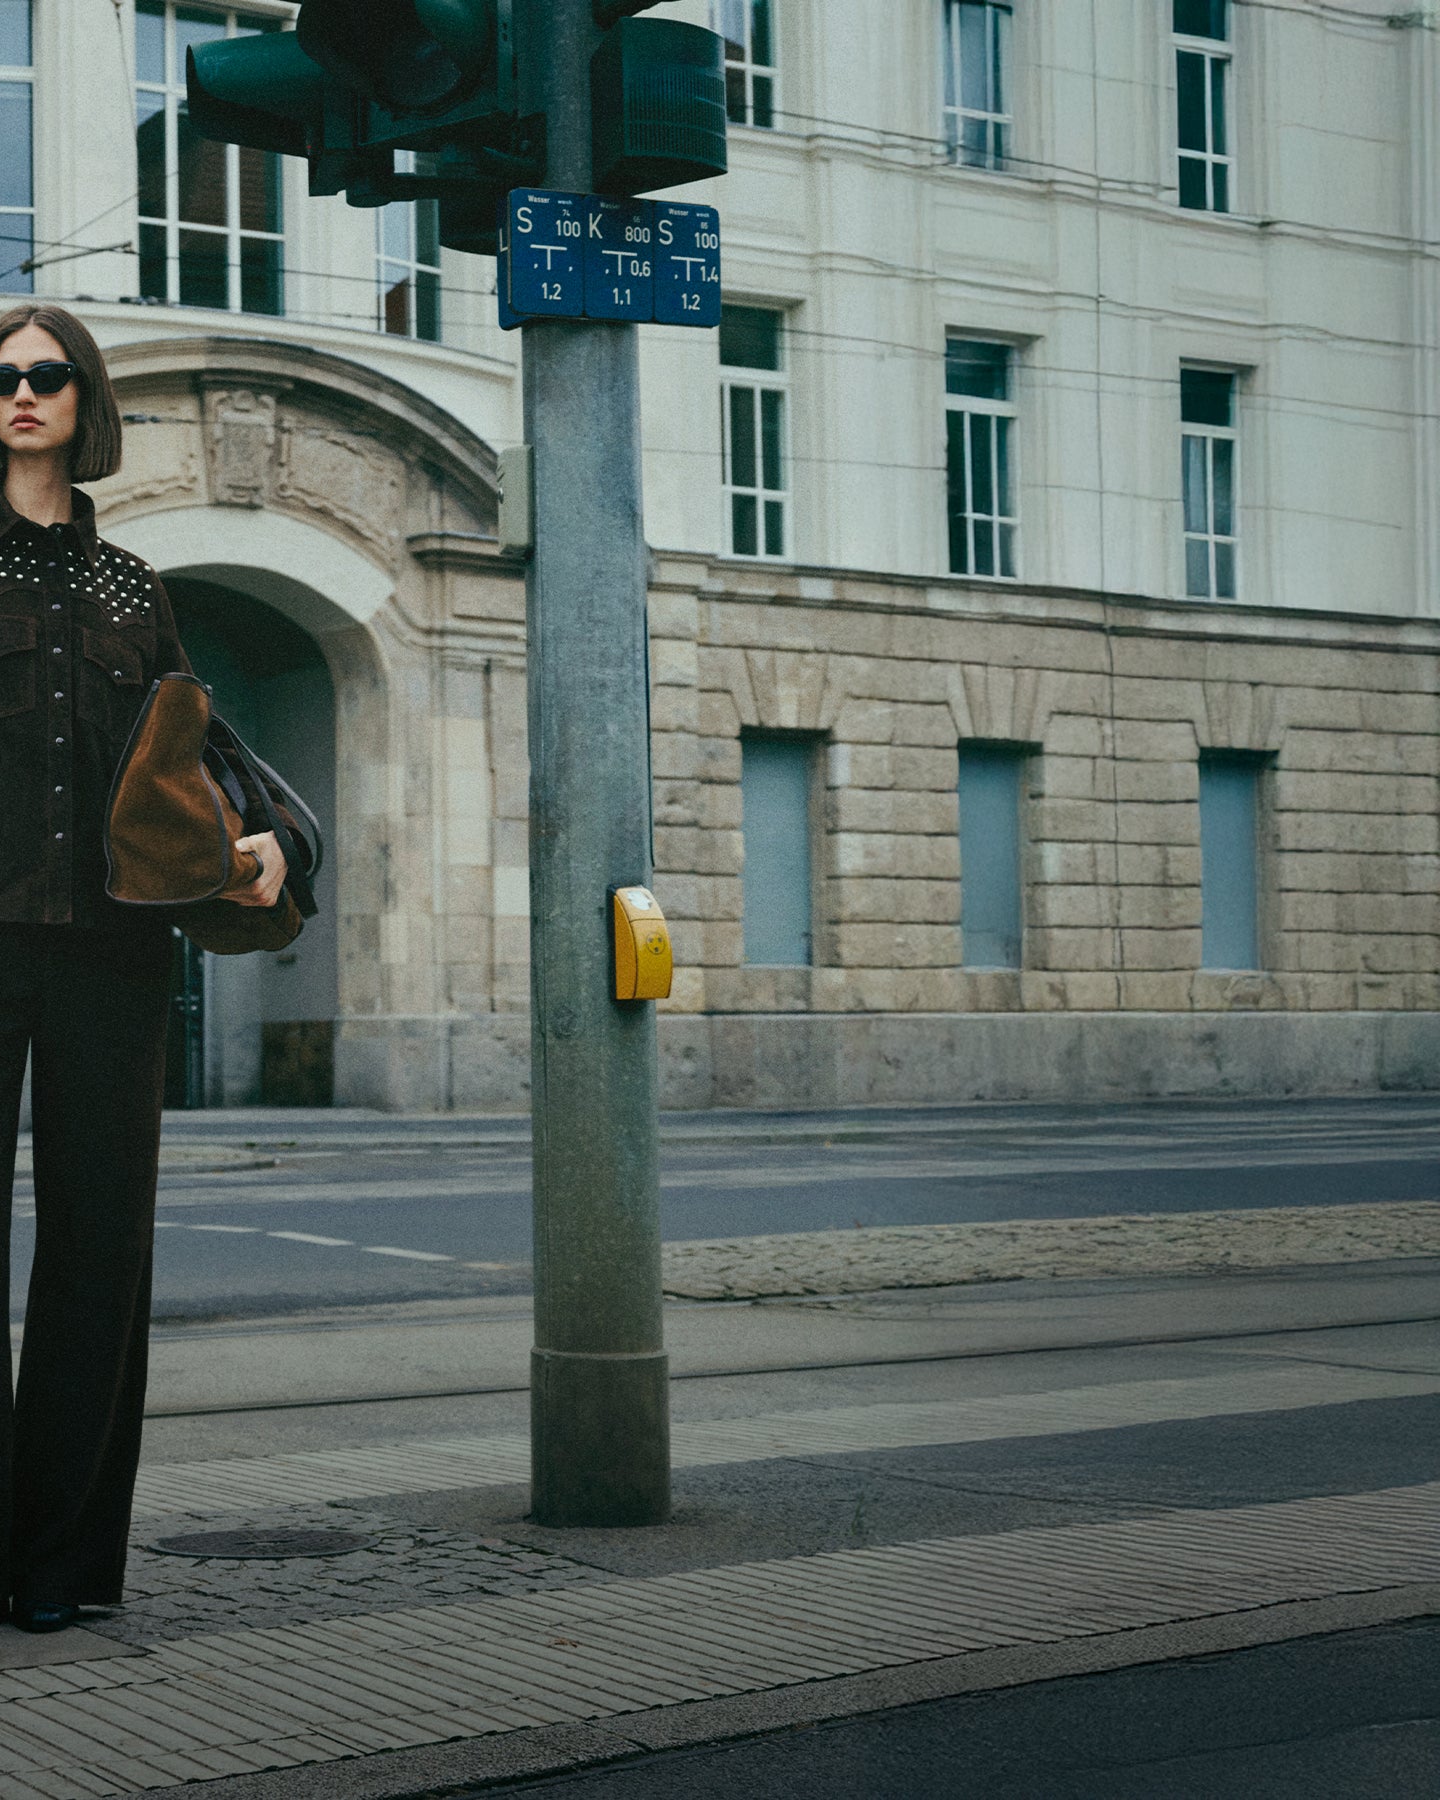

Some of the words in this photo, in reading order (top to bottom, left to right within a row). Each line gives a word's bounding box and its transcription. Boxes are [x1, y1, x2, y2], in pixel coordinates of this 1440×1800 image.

[517, 206, 533, 234] S
[556, 220, 581, 238] 100
[589, 213, 603, 239] K
[625, 226, 651, 243] 800
[658, 219, 674, 245] S
[694, 231, 719, 249] 100
[630, 260, 651, 277] 0,6
[700, 265, 719, 283] 1,4
[541, 282, 562, 300] 1,2
[612, 287, 631, 305] 1,1
[681, 293, 701, 311] 1,2
